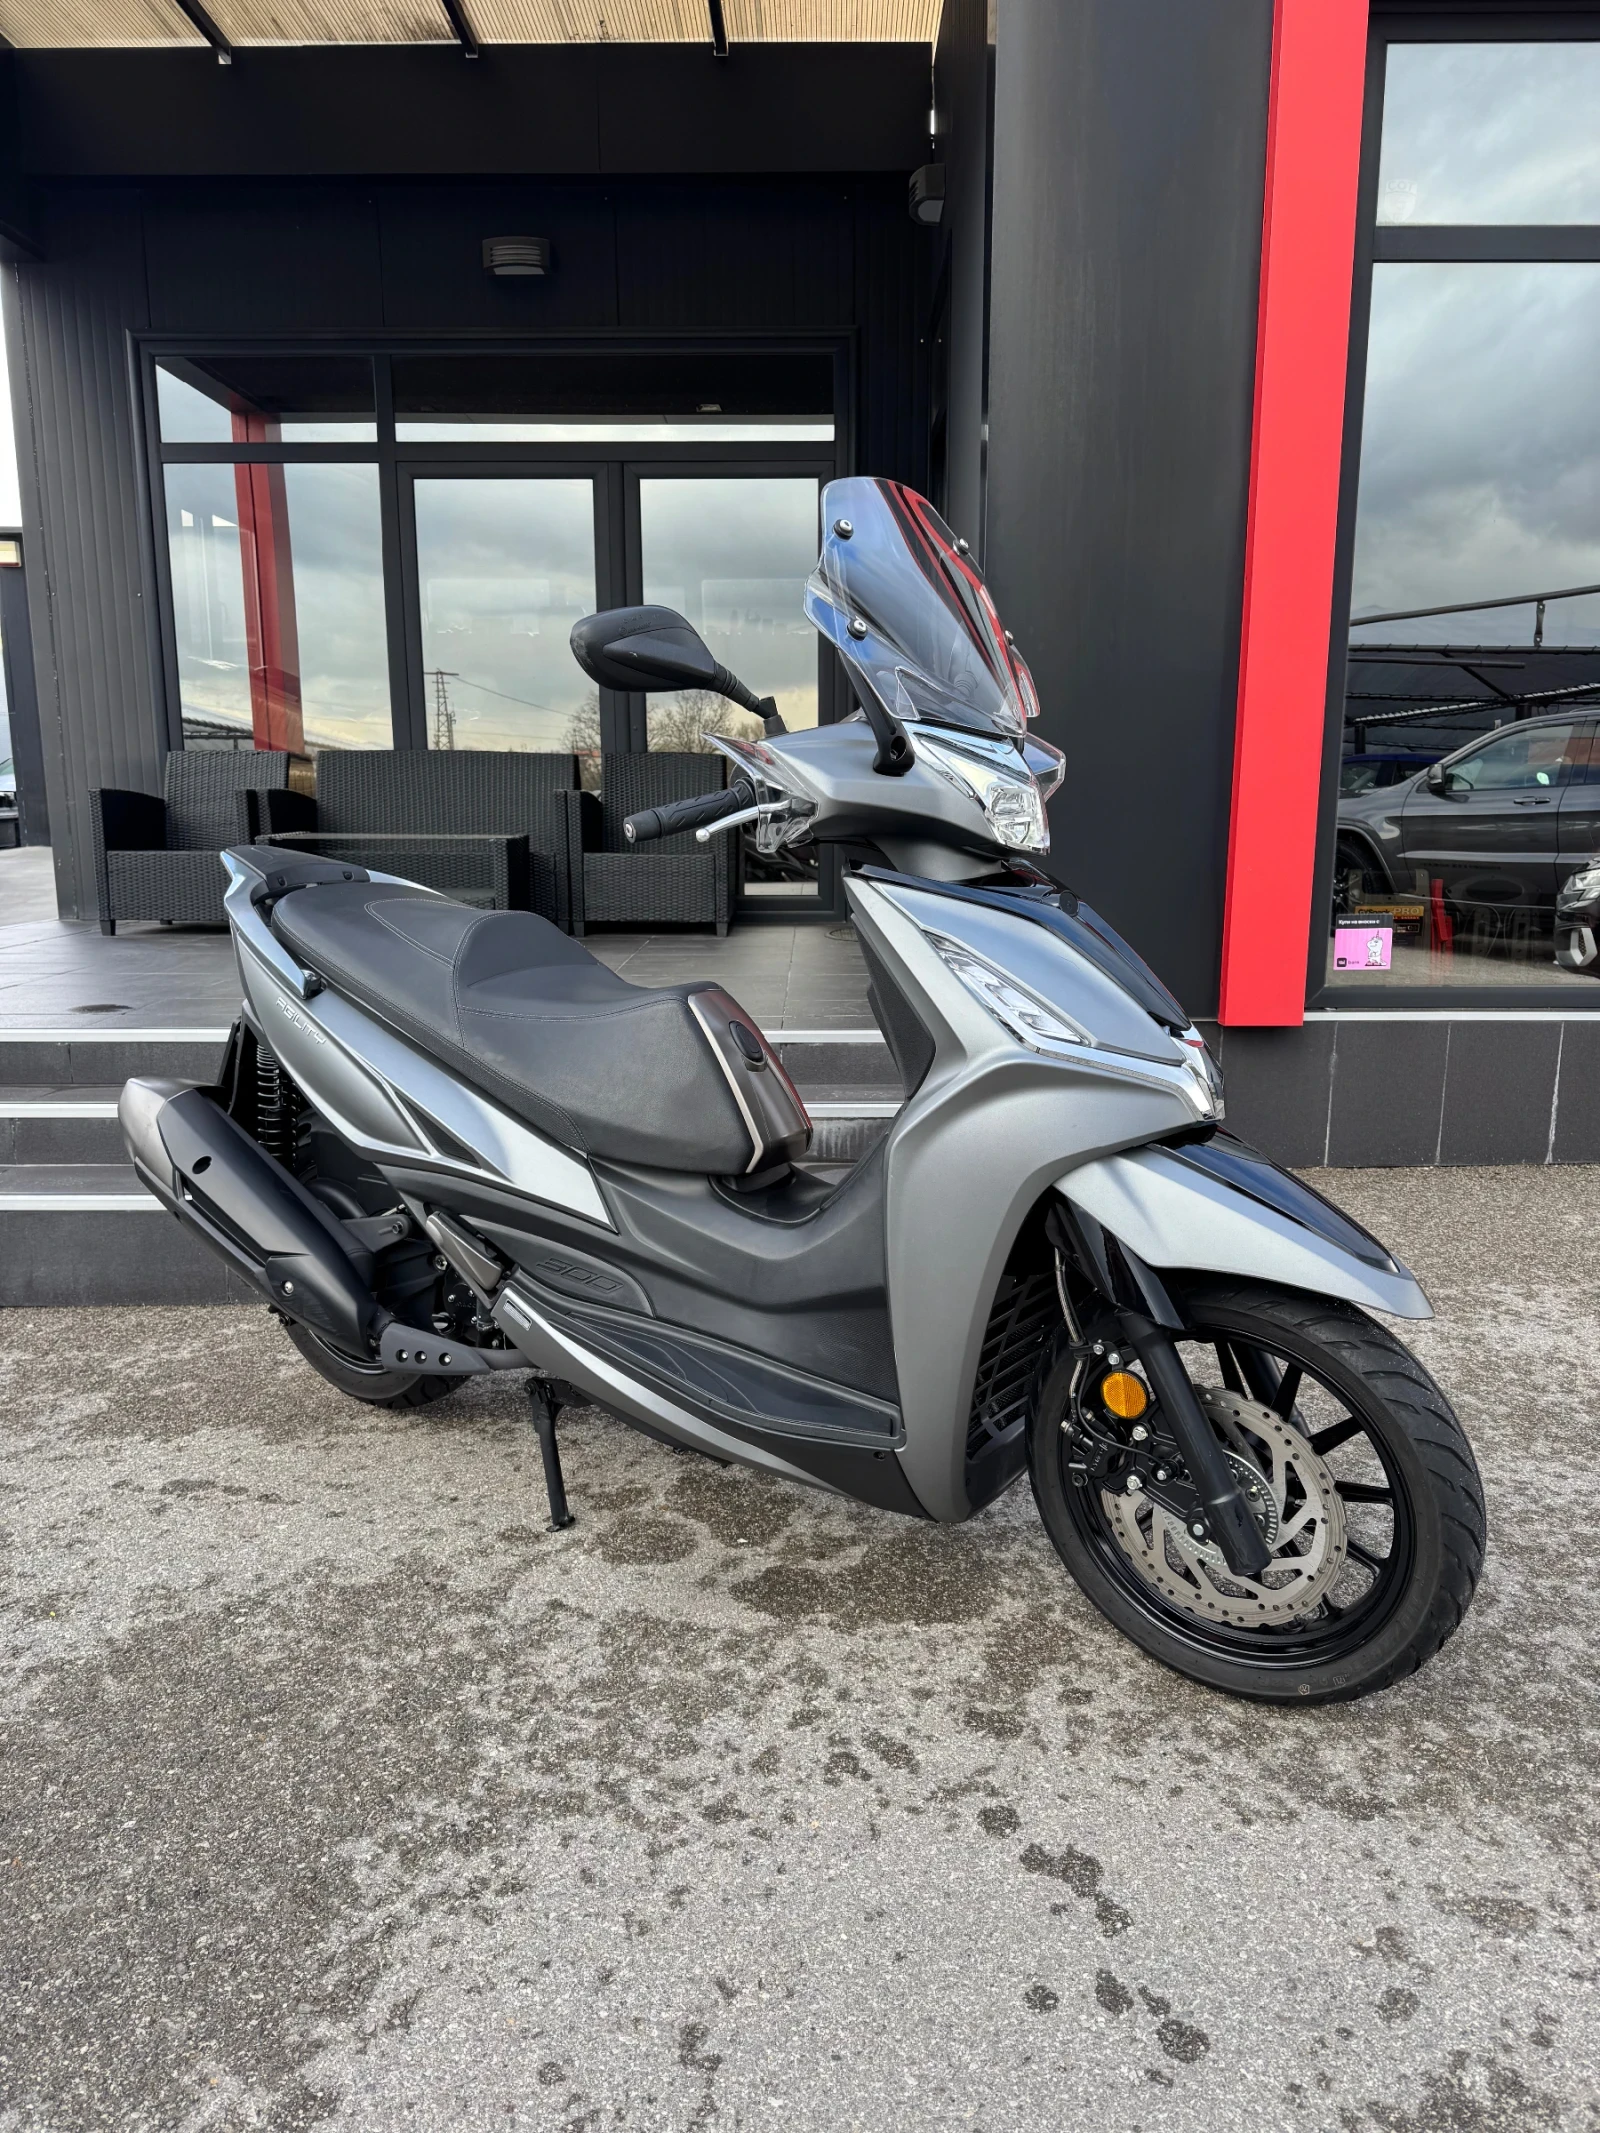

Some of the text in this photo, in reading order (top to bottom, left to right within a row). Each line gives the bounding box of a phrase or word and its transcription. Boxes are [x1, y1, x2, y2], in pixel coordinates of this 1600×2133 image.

[1393, 907, 1420, 915] PRO
[275, 996, 328, 1045] AGILITY
[536, 1257, 624, 1295] 300
